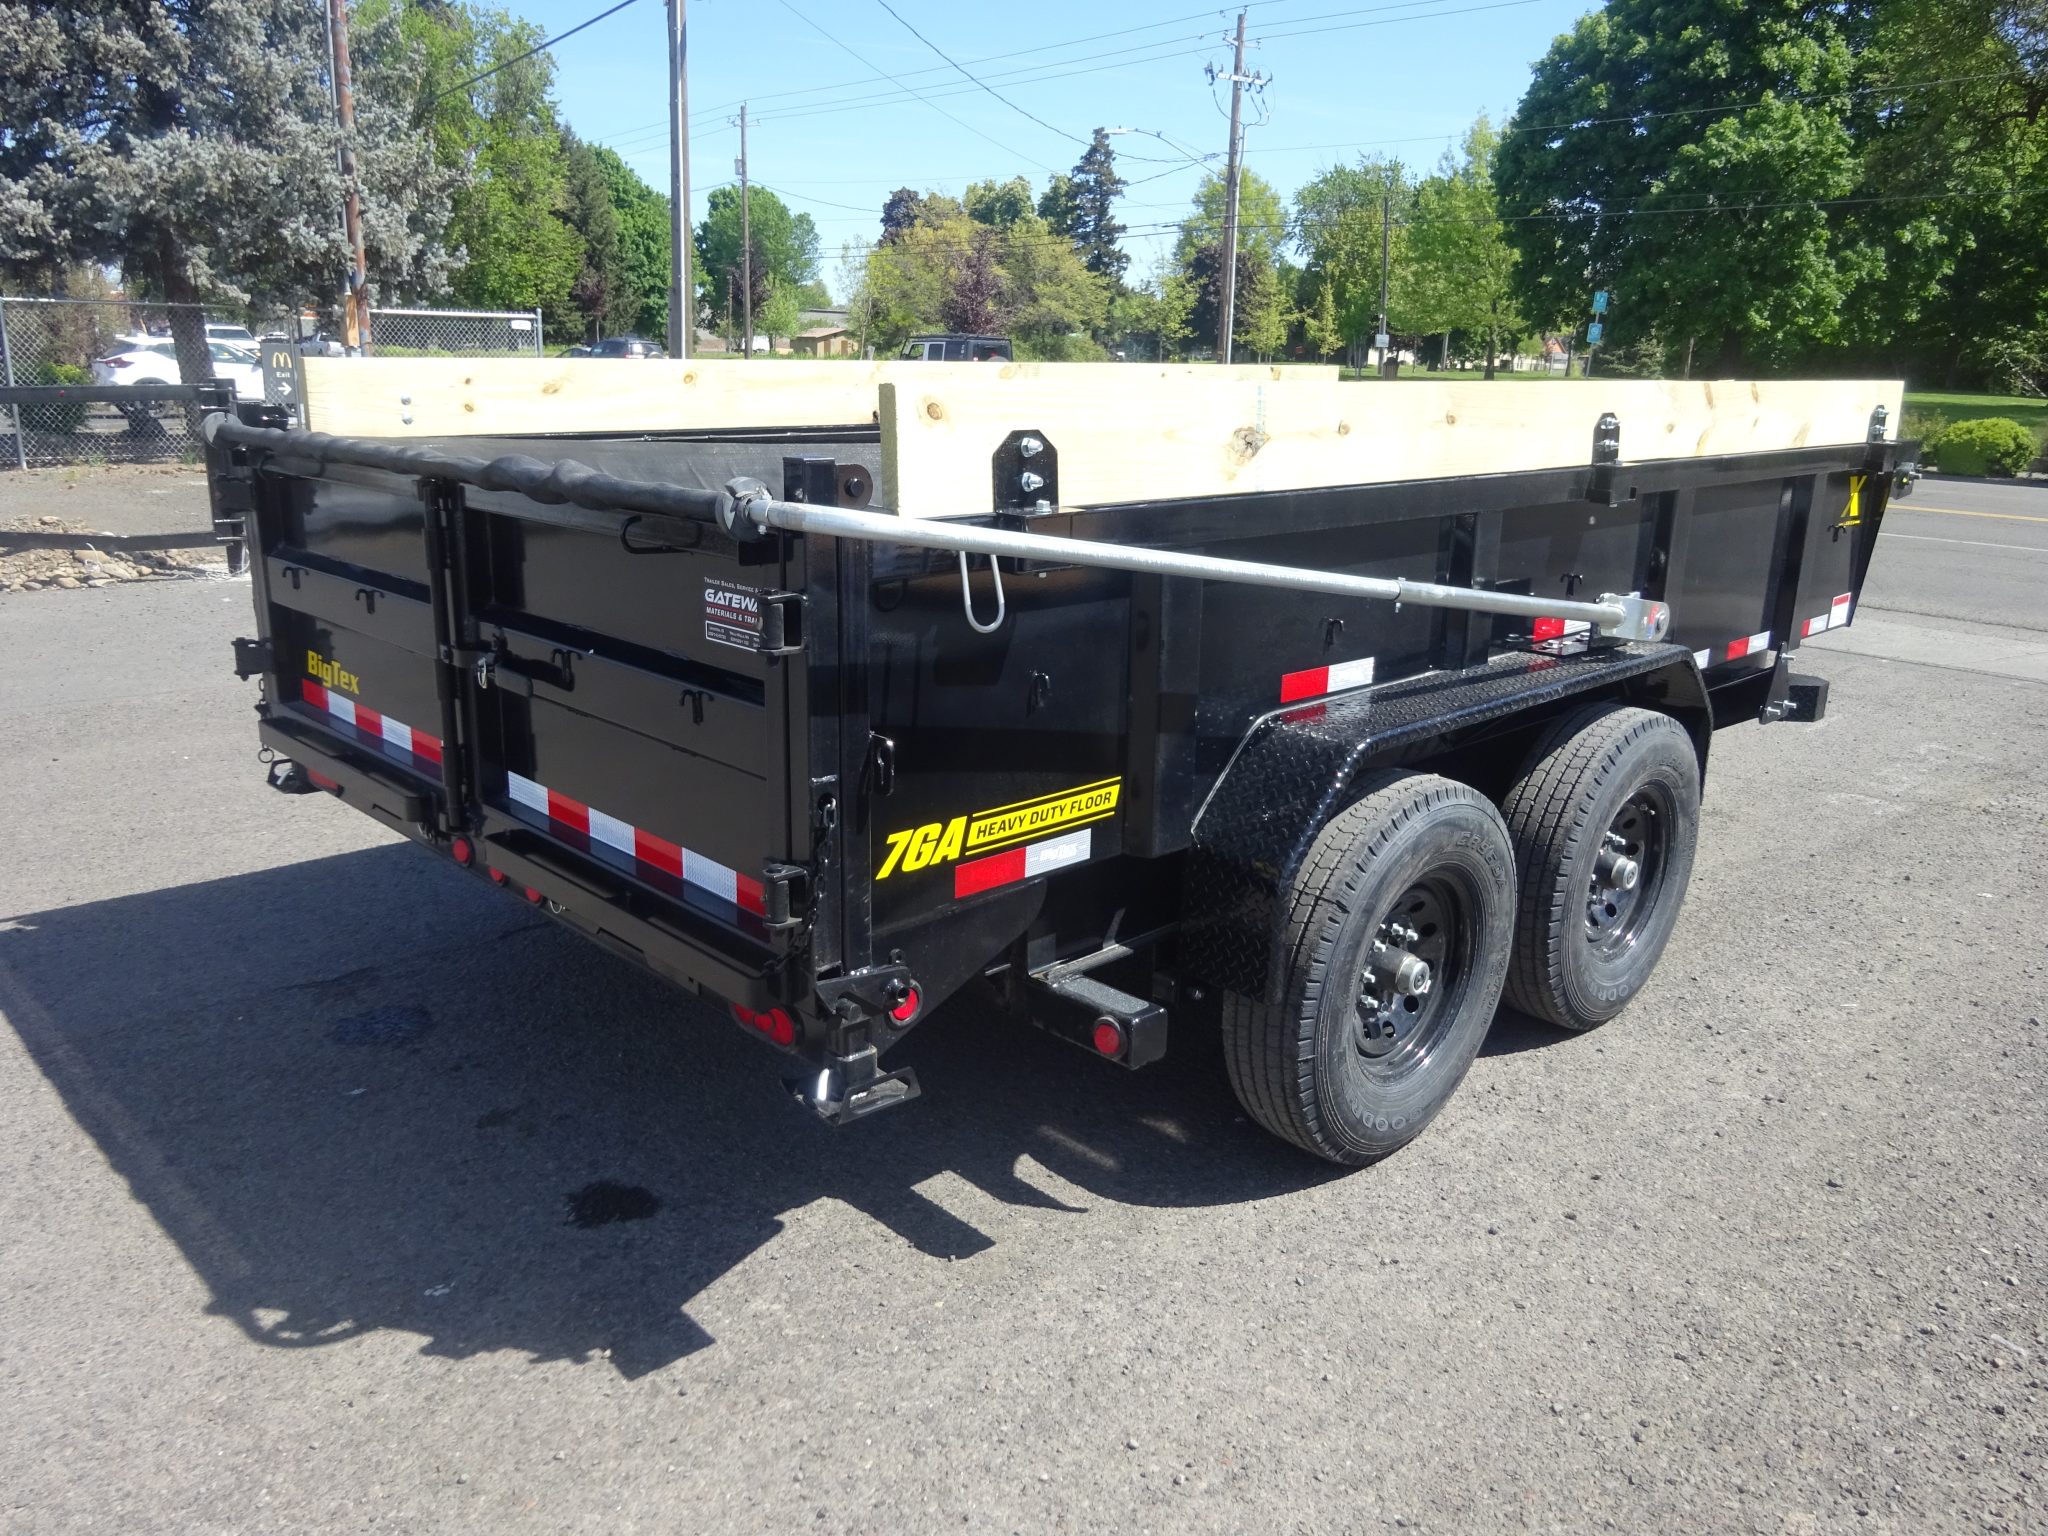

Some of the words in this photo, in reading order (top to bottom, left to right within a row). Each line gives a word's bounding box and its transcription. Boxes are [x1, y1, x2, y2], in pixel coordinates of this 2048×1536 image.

[705, 589, 758, 612] GATEWA
[706, 606, 737, 620] MATERIALS
[738, 614, 743, 622] &
[307, 649, 360, 695] BigTex
[875, 815, 968, 880] 7GA
[976, 814, 1026, 839] HEAVY
[1029, 803, 1067, 826] DUTY
[1070, 791, 1112, 814] FLOOR
